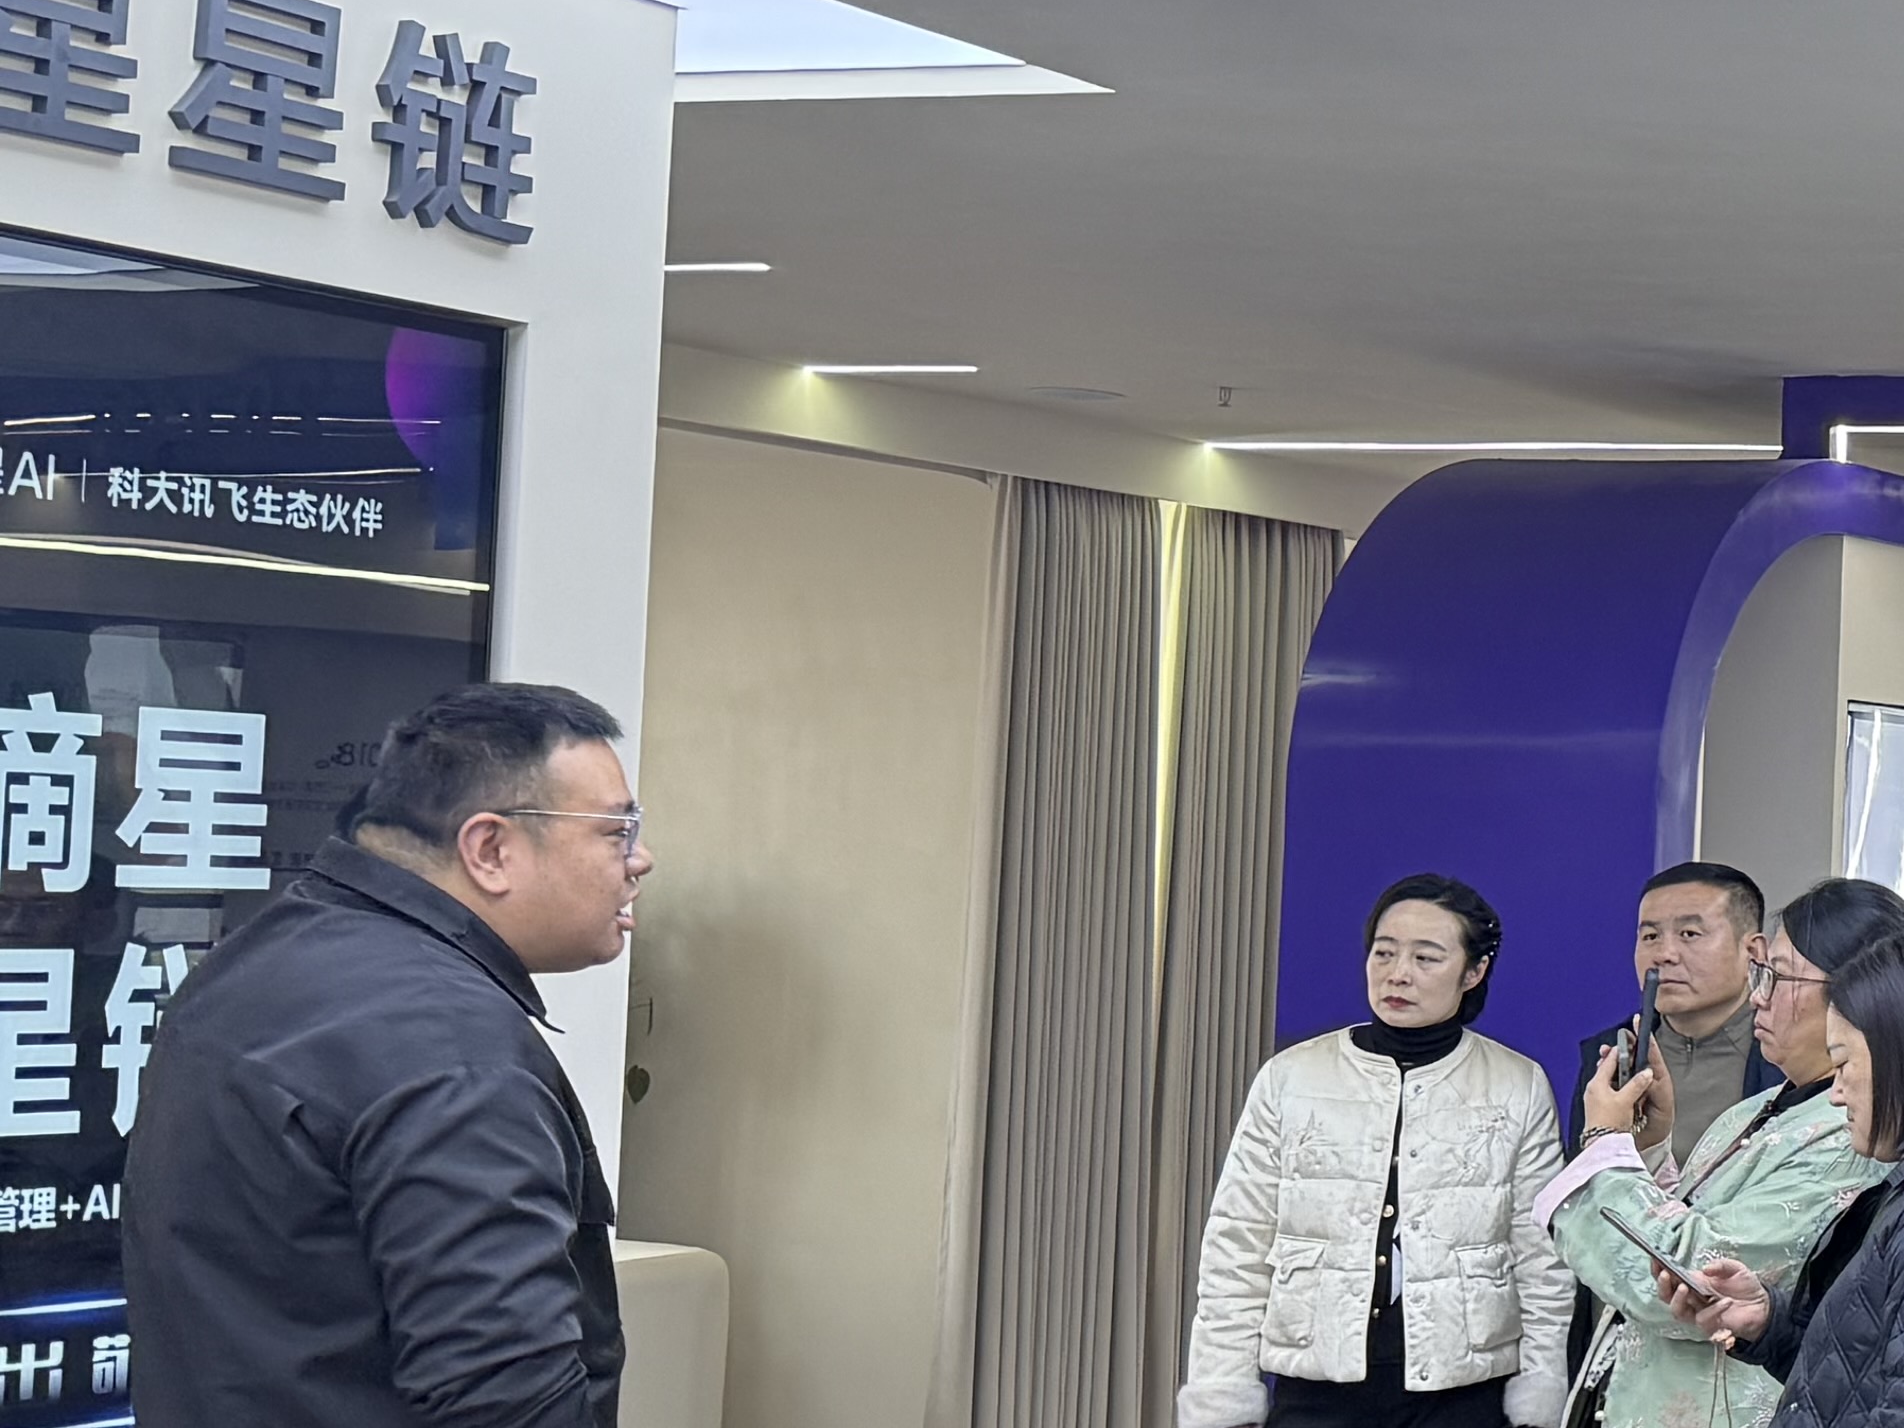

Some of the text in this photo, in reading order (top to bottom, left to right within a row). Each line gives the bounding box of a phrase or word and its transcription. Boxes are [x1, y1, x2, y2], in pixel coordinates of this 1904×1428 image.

[0, 447, 384, 538] AI 科大讯飞生态伙伴
